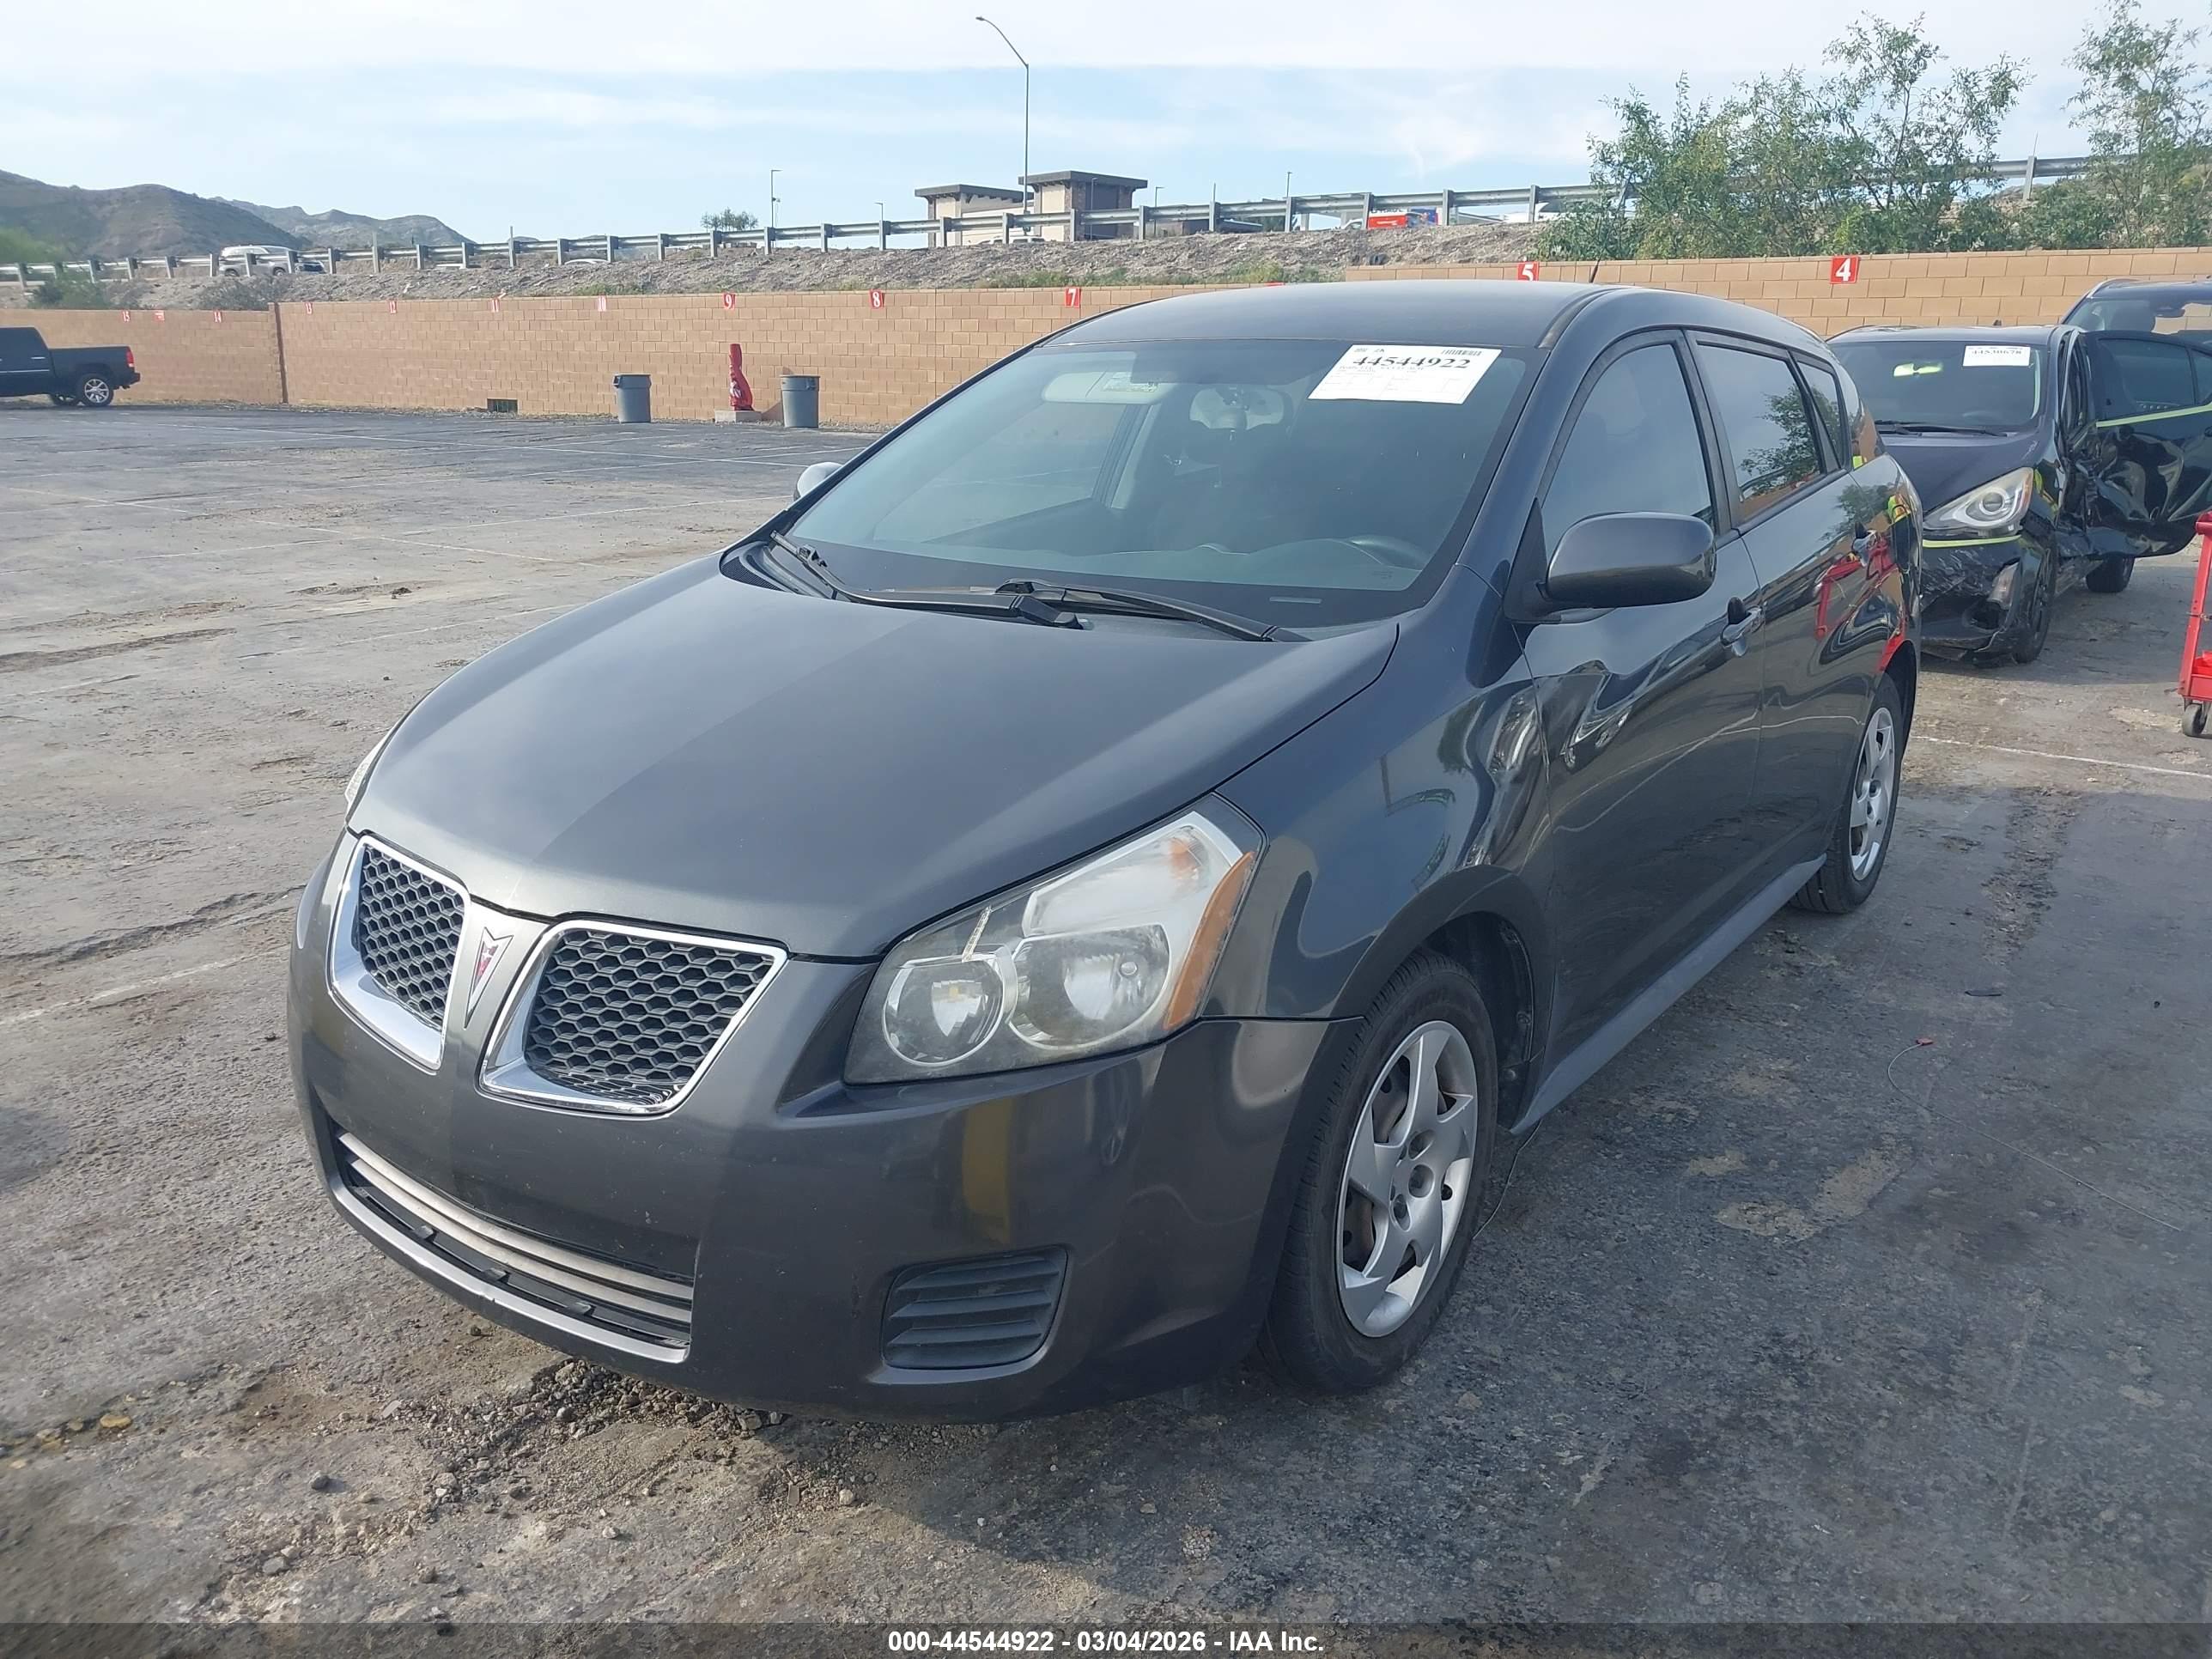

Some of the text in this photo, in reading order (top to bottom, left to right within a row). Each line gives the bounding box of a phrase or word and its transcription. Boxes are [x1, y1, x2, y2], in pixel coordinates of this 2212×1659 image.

[1522, 264, 1534, 282] 5
[1835, 258, 1851, 282] 4
[598, 296, 606, 311] 10
[725, 294, 732, 309] 9
[872, 291, 880, 307] 8
[1068, 288, 1076, 307] 7
[491, 299, 499, 312] 11
[1353, 356, 1470, 369] 44544922
